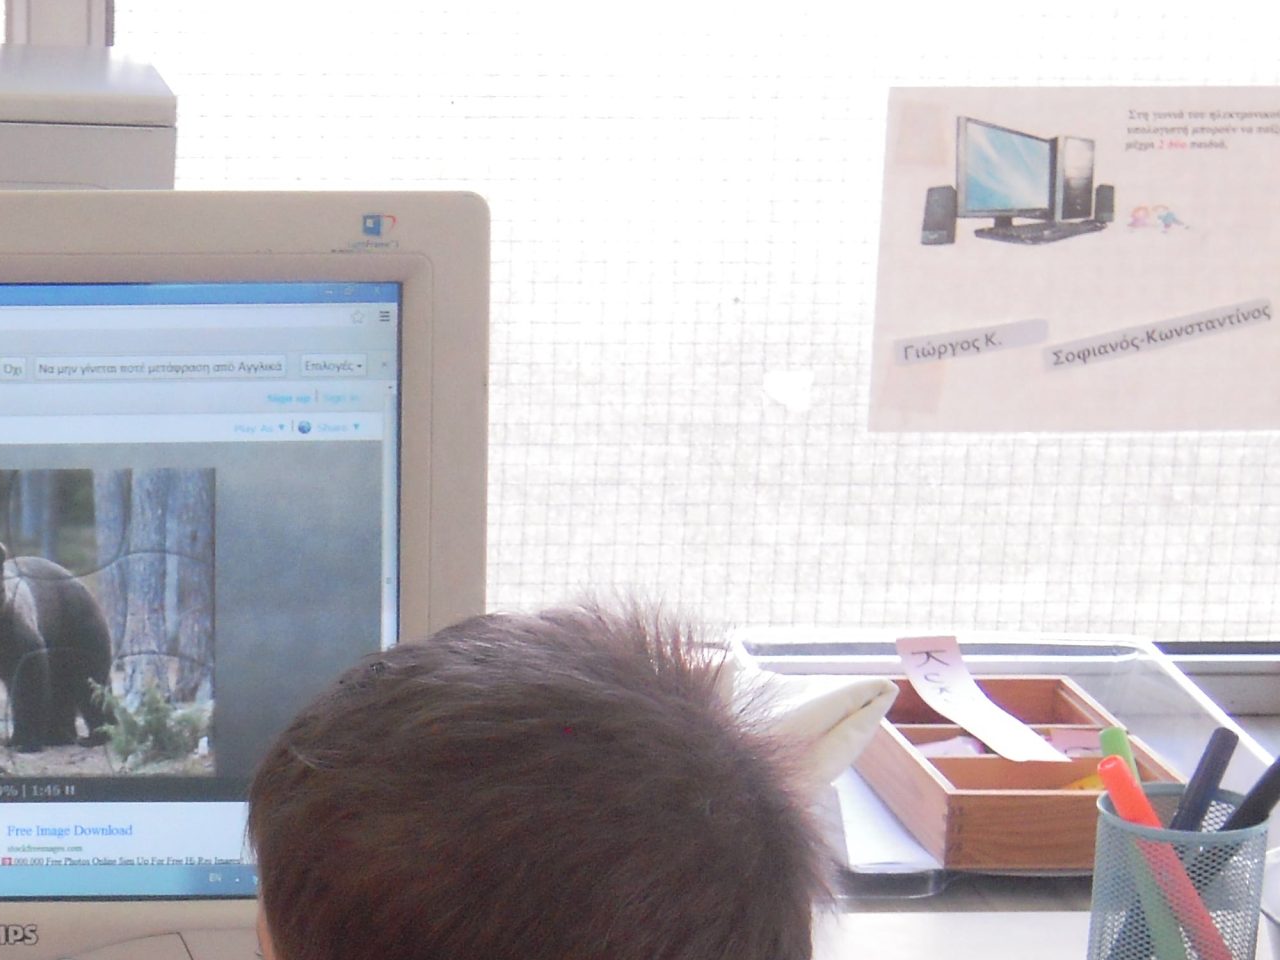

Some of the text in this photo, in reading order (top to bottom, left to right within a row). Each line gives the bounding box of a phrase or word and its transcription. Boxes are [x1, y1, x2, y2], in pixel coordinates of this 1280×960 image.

[1053, 304, 1271, 366] Σοφιανός-Κωνσταντίνος
[904, 331, 1002, 361] Γιώργος Κ.
[39, 364, 55, 374] Να
[58, 365, 78, 376] μην
[148, 362, 210, 376] μετάφραση
[238, 361, 283, 374] Αγγλικά
[305, 360, 353, 373] Επιλογές
[7, 824, 133, 839] Free Image Download
